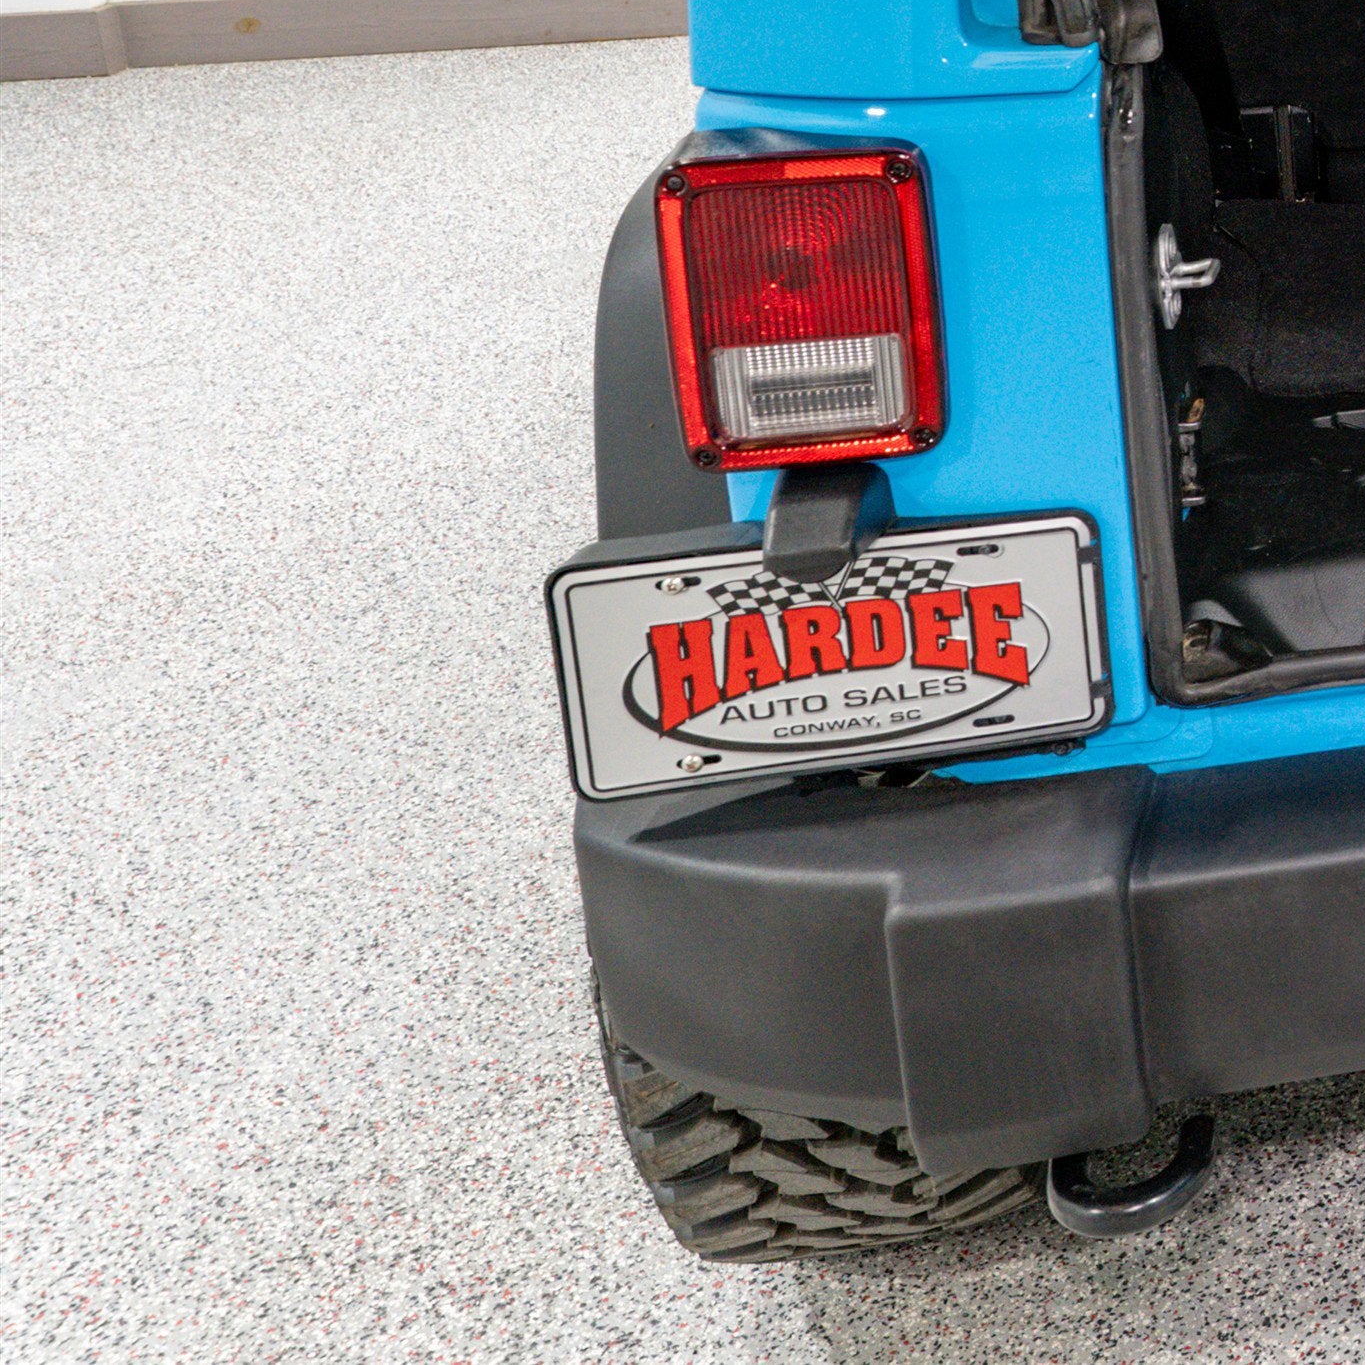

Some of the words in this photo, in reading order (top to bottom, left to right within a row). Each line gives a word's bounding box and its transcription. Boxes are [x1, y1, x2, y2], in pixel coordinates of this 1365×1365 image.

[646, 581, 1031, 737] HARDEE
[720, 694, 829, 725] AUTO
[843, 676, 968, 709] SALES
[773, 714, 881, 739] CONWAY,
[890, 708, 922, 724] SC
